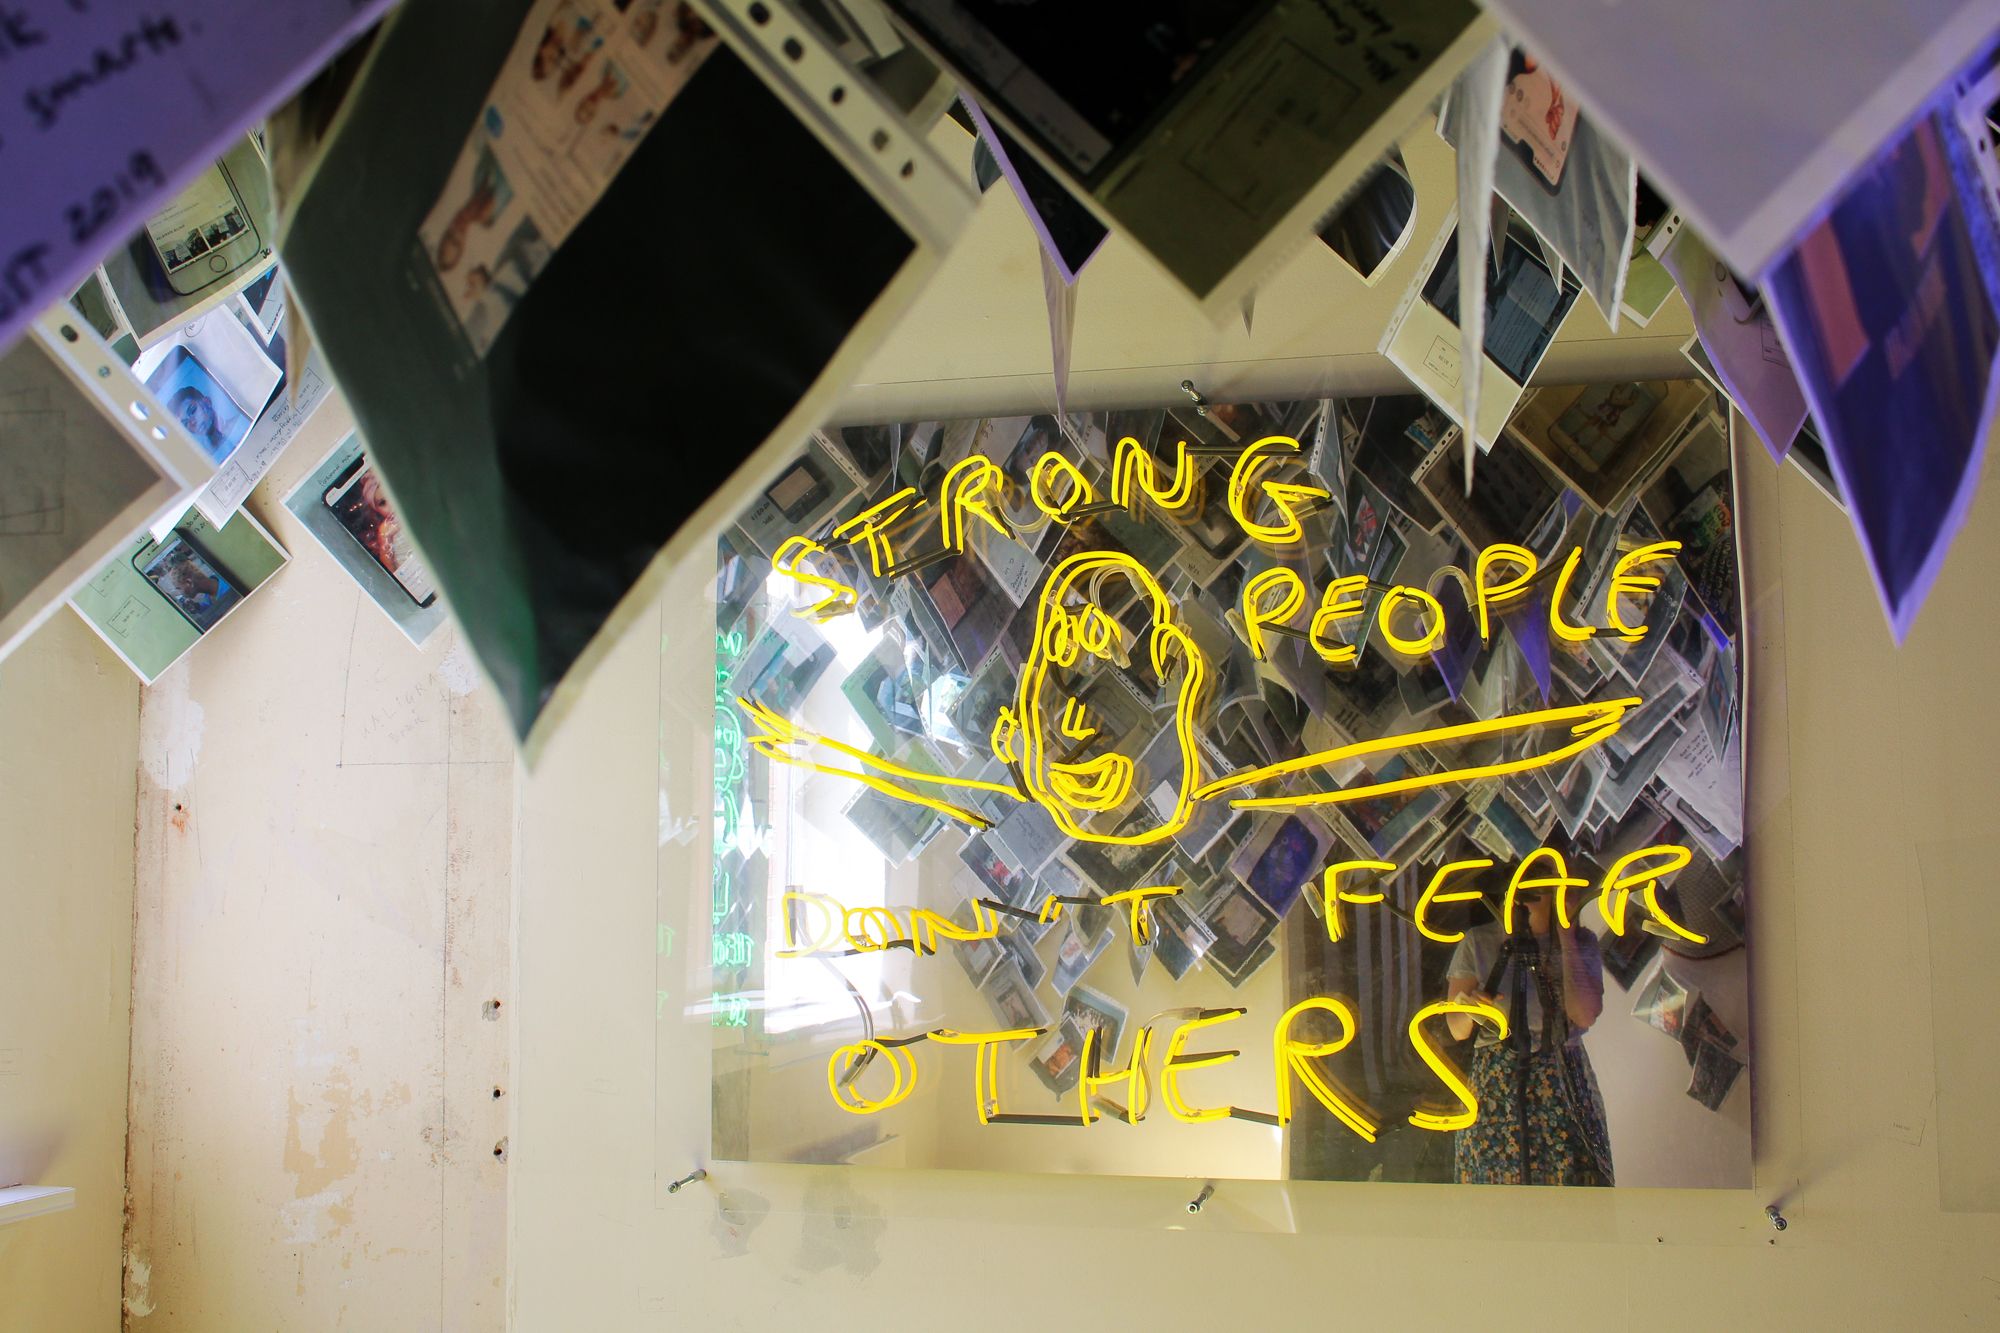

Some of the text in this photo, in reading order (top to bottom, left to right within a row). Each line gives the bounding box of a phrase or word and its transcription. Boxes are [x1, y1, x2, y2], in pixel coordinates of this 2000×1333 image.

[772, 435, 1330, 622] STRONG
[1243, 541, 1682, 662] PEOPLE
[1324, 845, 1708, 944] FEAR
[828, 997, 1509, 1142] OTHERS
